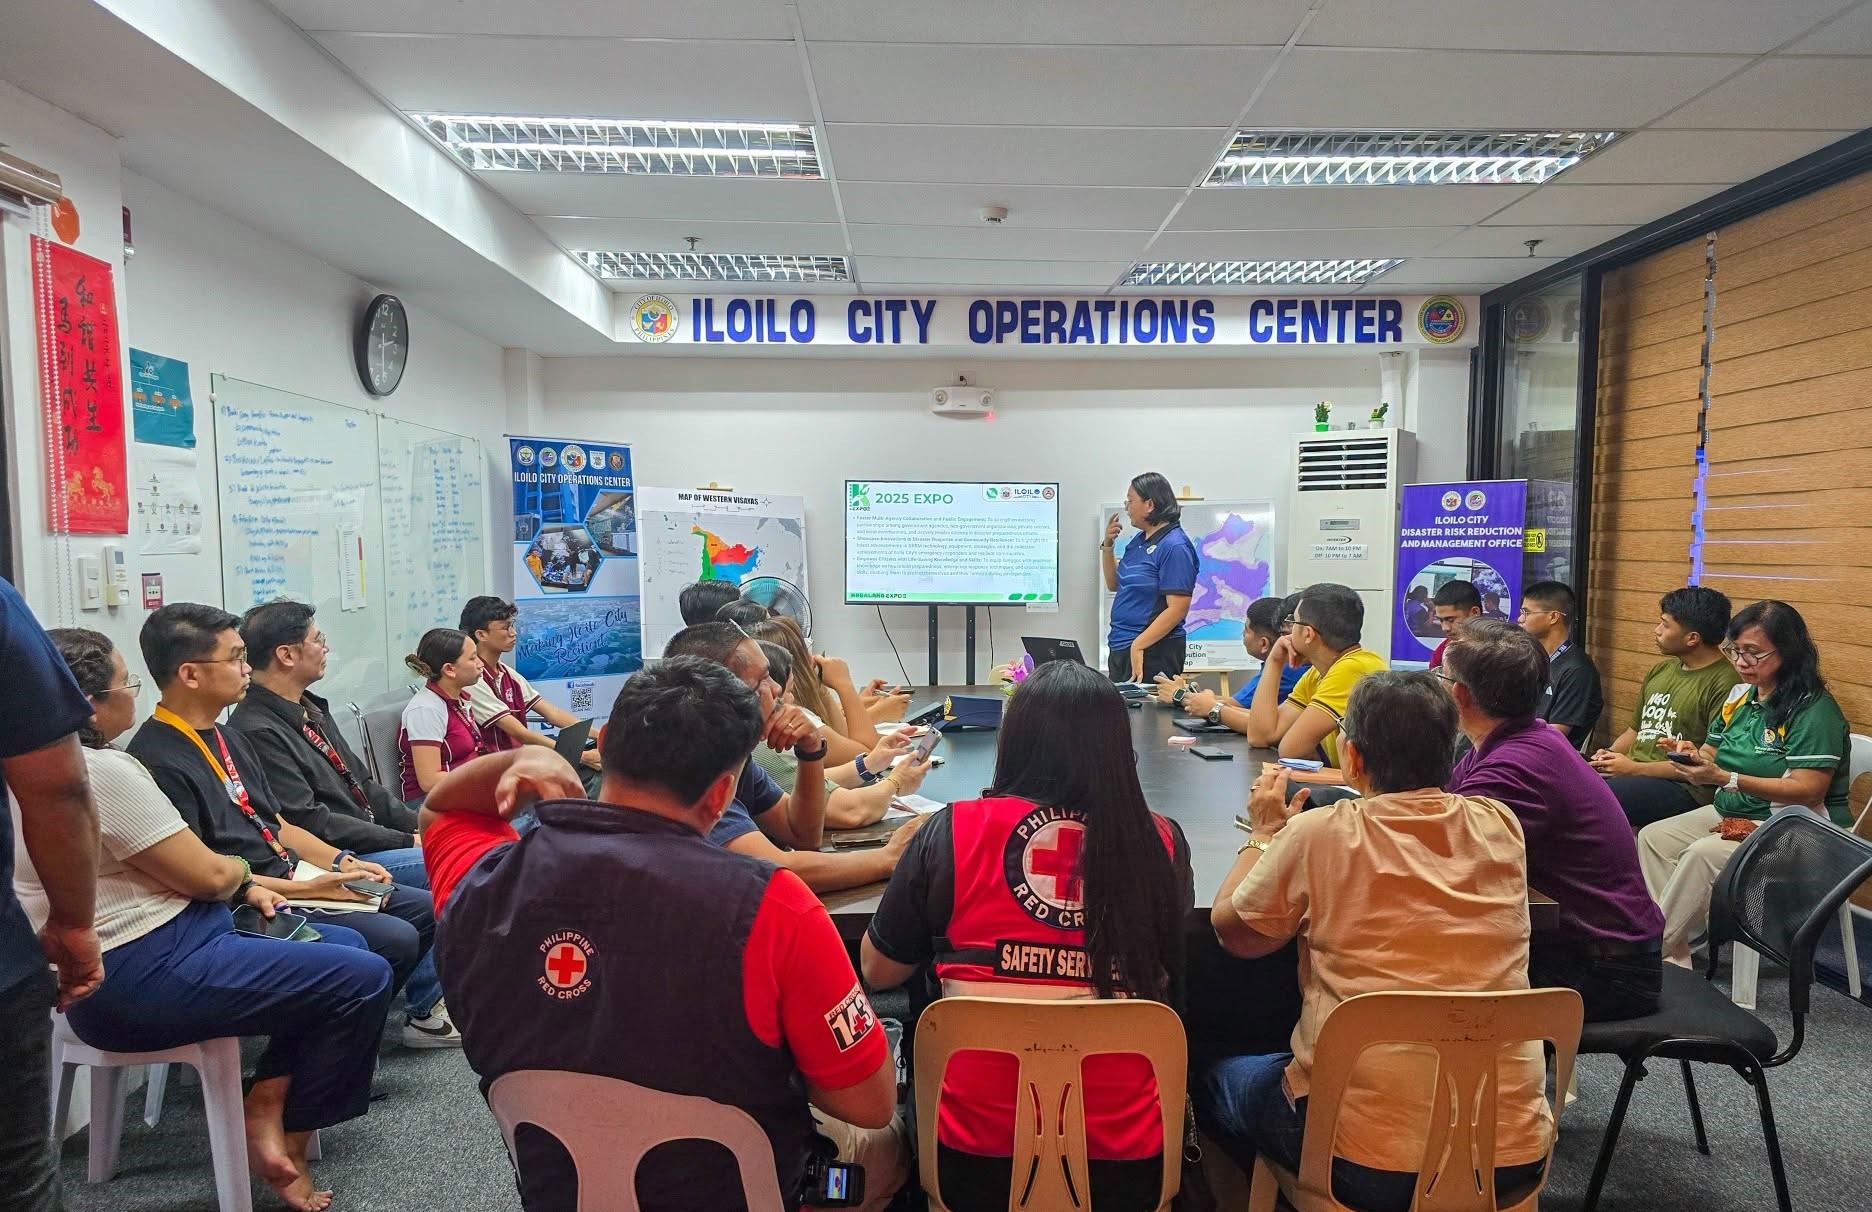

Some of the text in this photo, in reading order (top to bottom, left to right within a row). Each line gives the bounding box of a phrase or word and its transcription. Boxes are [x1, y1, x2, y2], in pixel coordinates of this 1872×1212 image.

[382, 303, 389, 316] 12
[692, 298, 815, 343] ILOILO
[847, 298, 936, 343] CITY
[970, 299, 1215, 344] OPERATIONS
[1249, 299, 1402, 343] CENTER
[514, 471, 631, 487] ILOILO CITY OPERATIONS CENTER
[678, 493, 759, 505] MAP OF WESTERN VISAYAS
[875, 493, 954, 504] 2025 EXPO
[1435, 515, 1489, 525] ILOILO CITY
[1401, 527, 1523, 537] DISASTER RISK REDUCTION
[1401, 540, 1421, 548] AND
[1421, 539, 1487, 548] MANAGEMENT
[1488, 538, 1523, 548] OFFICE
[518, 634, 563, 658] Making
[605, 606, 628, 627] City
[1017, 807, 1088, 840] PHILIP
[1013, 882, 1049, 919] RED
[540, 931, 595, 957] PHILIPPINE
[1001, 943, 1055, 974] SAFETY
[537, 976, 592, 999] RED CROSS
[829, 1004, 845, 1018] RED
[832, 993, 874, 1047] 143
